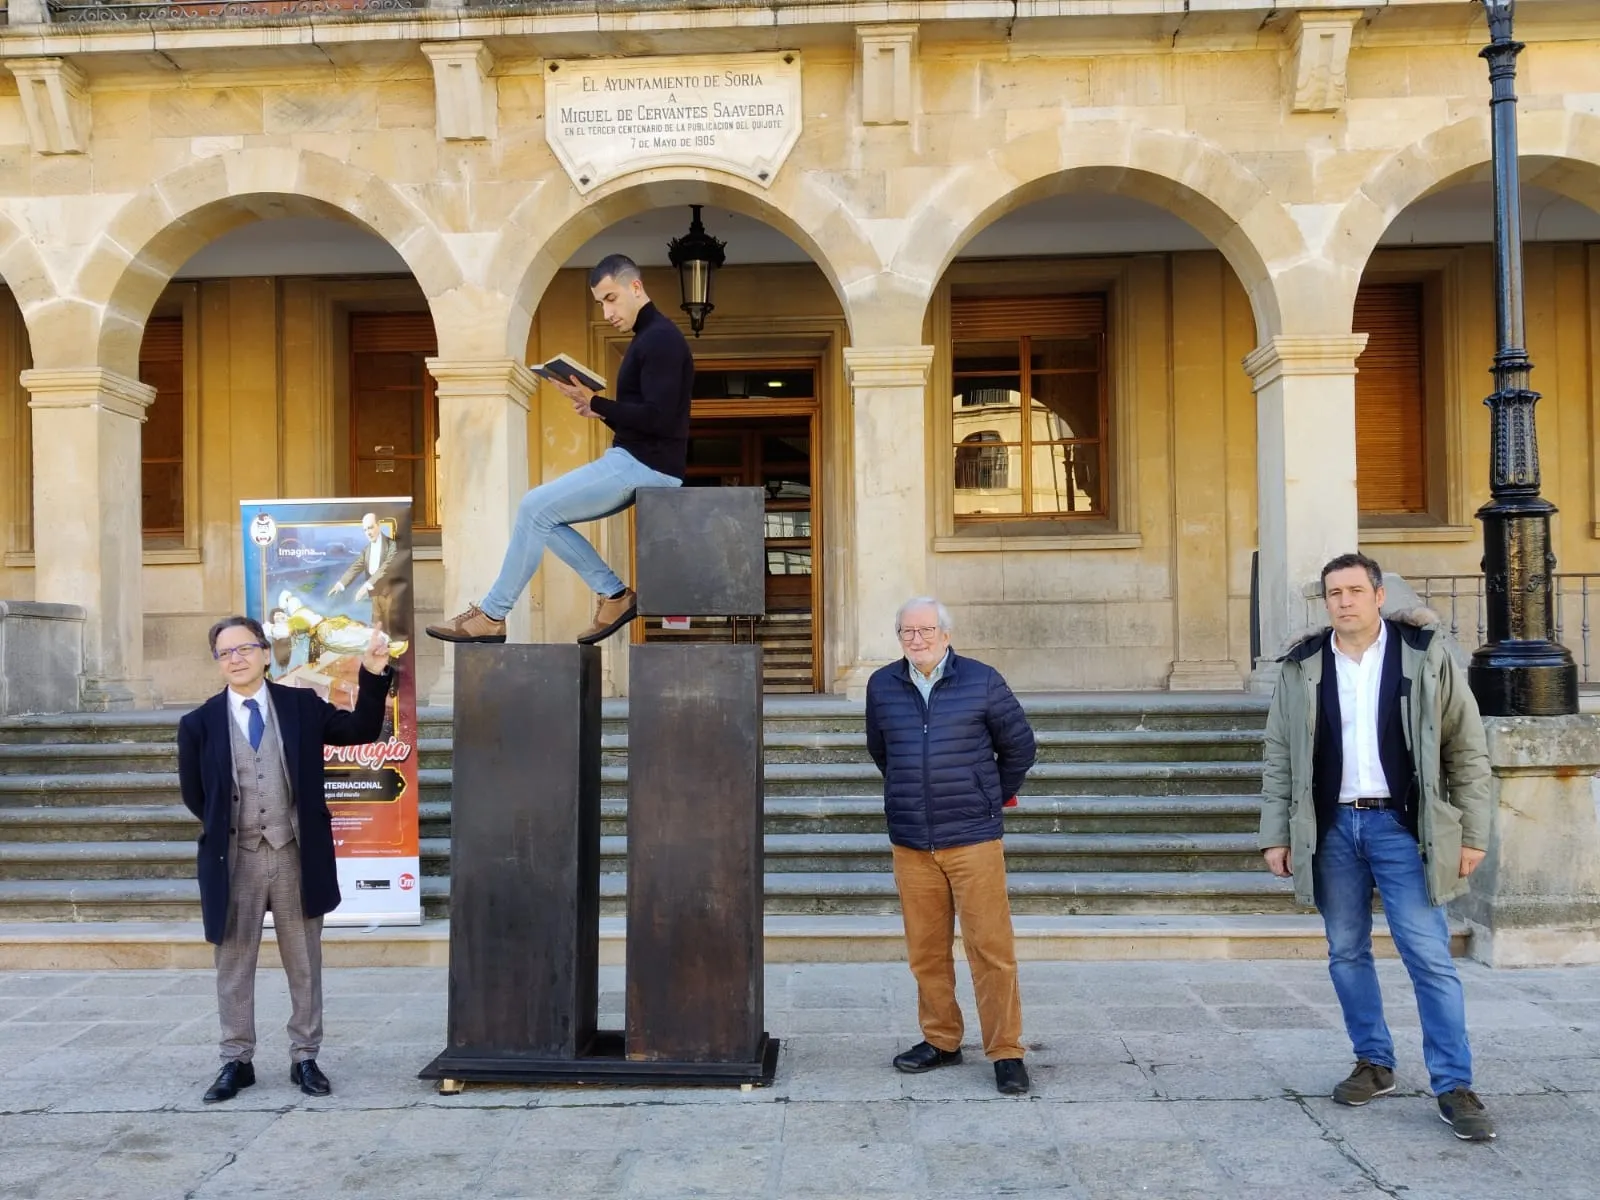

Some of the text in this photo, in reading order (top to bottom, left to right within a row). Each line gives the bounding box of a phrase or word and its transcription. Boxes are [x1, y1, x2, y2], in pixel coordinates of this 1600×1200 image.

[582, 70, 763, 92] EL AYUNTAMIENTO DE SORIA
[668, 92, 677, 103] A
[561, 102, 785, 124] MIGUEL DE CERVANTES SAAVEDRA
[565, 127, 574, 136] EN
[576, 126, 585, 135] EL
[588, 126, 616, 136] TERCER
[618, 124, 663, 134] CENTENARIO
[664, 123, 673, 132] DE
[676, 122, 686, 132] LA
[736, 120, 749, 130] DEL
[752, 119, 782, 131] QUIJOTE
[631, 135, 716, 149] 7 DE MAYO DE 1905
[324, 781, 383, 790] NTERNACIONAL
